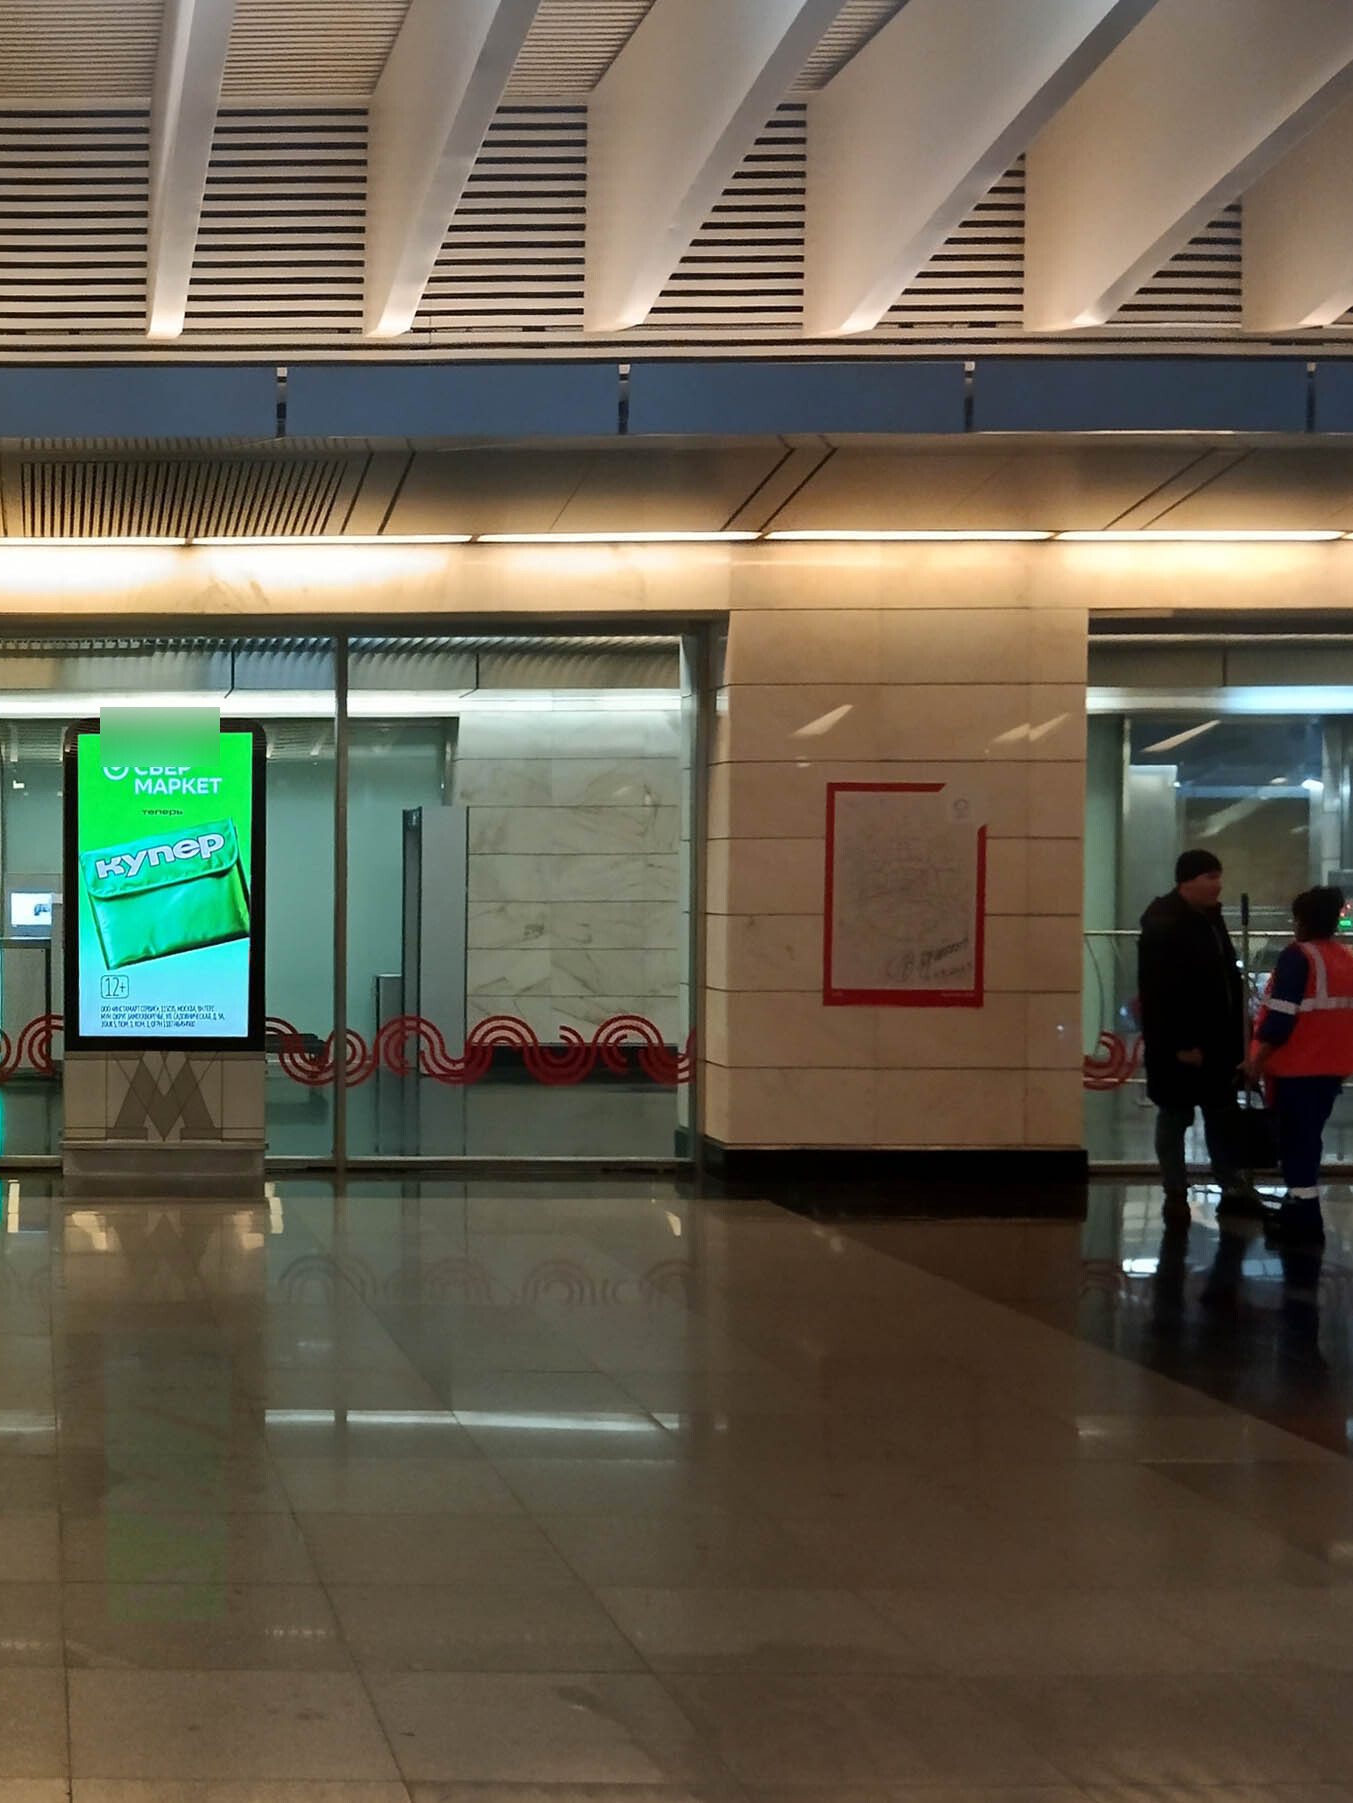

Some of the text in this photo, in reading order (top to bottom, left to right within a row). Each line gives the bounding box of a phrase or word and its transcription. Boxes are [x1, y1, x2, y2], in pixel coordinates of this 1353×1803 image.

[134, 778, 223, 795] МАРКЕТ
[95, 833, 225, 879] купер
[105, 977, 126, 997] 12+
